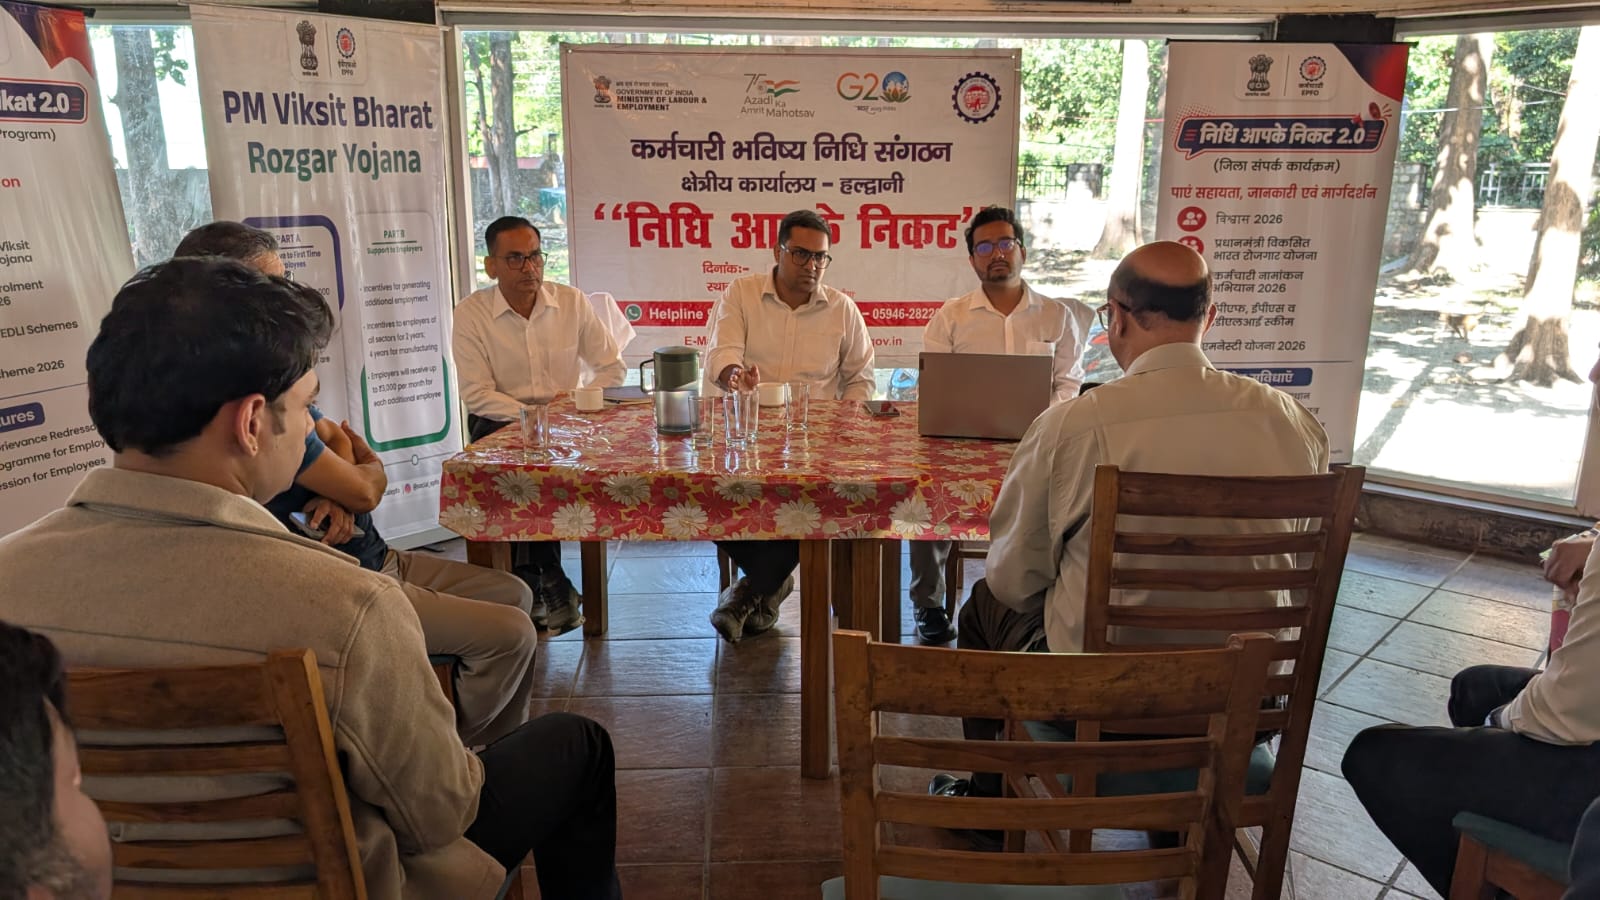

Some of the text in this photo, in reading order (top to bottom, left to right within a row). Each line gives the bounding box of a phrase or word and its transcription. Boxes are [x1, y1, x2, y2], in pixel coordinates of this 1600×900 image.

[0, 89, 70, 114] kat 2.0
[744, 95, 773, 105] Azadi
[223, 90, 433, 129] PM Viksit Bharat
[741, 106, 815, 118] Amrit Mahotsav
[0, 128, 56, 142] rogram)
[1200, 122, 1365, 144] निधि आपके निकट 2.0
[630, 130, 953, 162] कर्मचारी भविष्य निधि संगठन
[248, 142, 422, 181] Rozgar Yojana
[1213, 158, 1341, 173] (जिला संपर्क कार्यक्रम)
[1, 178, 21, 188] on
[681, 170, 733, 193] क्षेत्रीय
[738, 171, 816, 193] कार्यालय
[840, 171, 904, 194] हल्द्वानी
[1171, 184, 1378, 200] पाएं सहायता, जानकारी एवं मार्गदर्शन
[1254, 214, 1283, 224] 2026
[1215, 236, 1311, 248] प्रधानमंत्री विकसित
[1213, 249, 1318, 260] भारत रोजगार योजना
[1213, 269, 1304, 280] कर्मचारी नामांकन
[1257, 283, 1286, 293] 2026
[649, 307, 703, 322] Helpline
[1215, 302, 1296, 314] पीएफ, ईपीएस व
[1264, 315, 1295, 327] स्कीम
[1, 321, 78, 338] EDLI Schemes
[1245, 340, 1275, 350] योजना
[1278, 341, 1306, 350] 2026
[37, 360, 64, 372] 2026
[0, 410, 36, 427] ures
[0, 435, 48, 452] rievance
[53, 448, 66, 458] for
[33, 472, 48, 482] for
[50, 458, 106, 478] Employees
